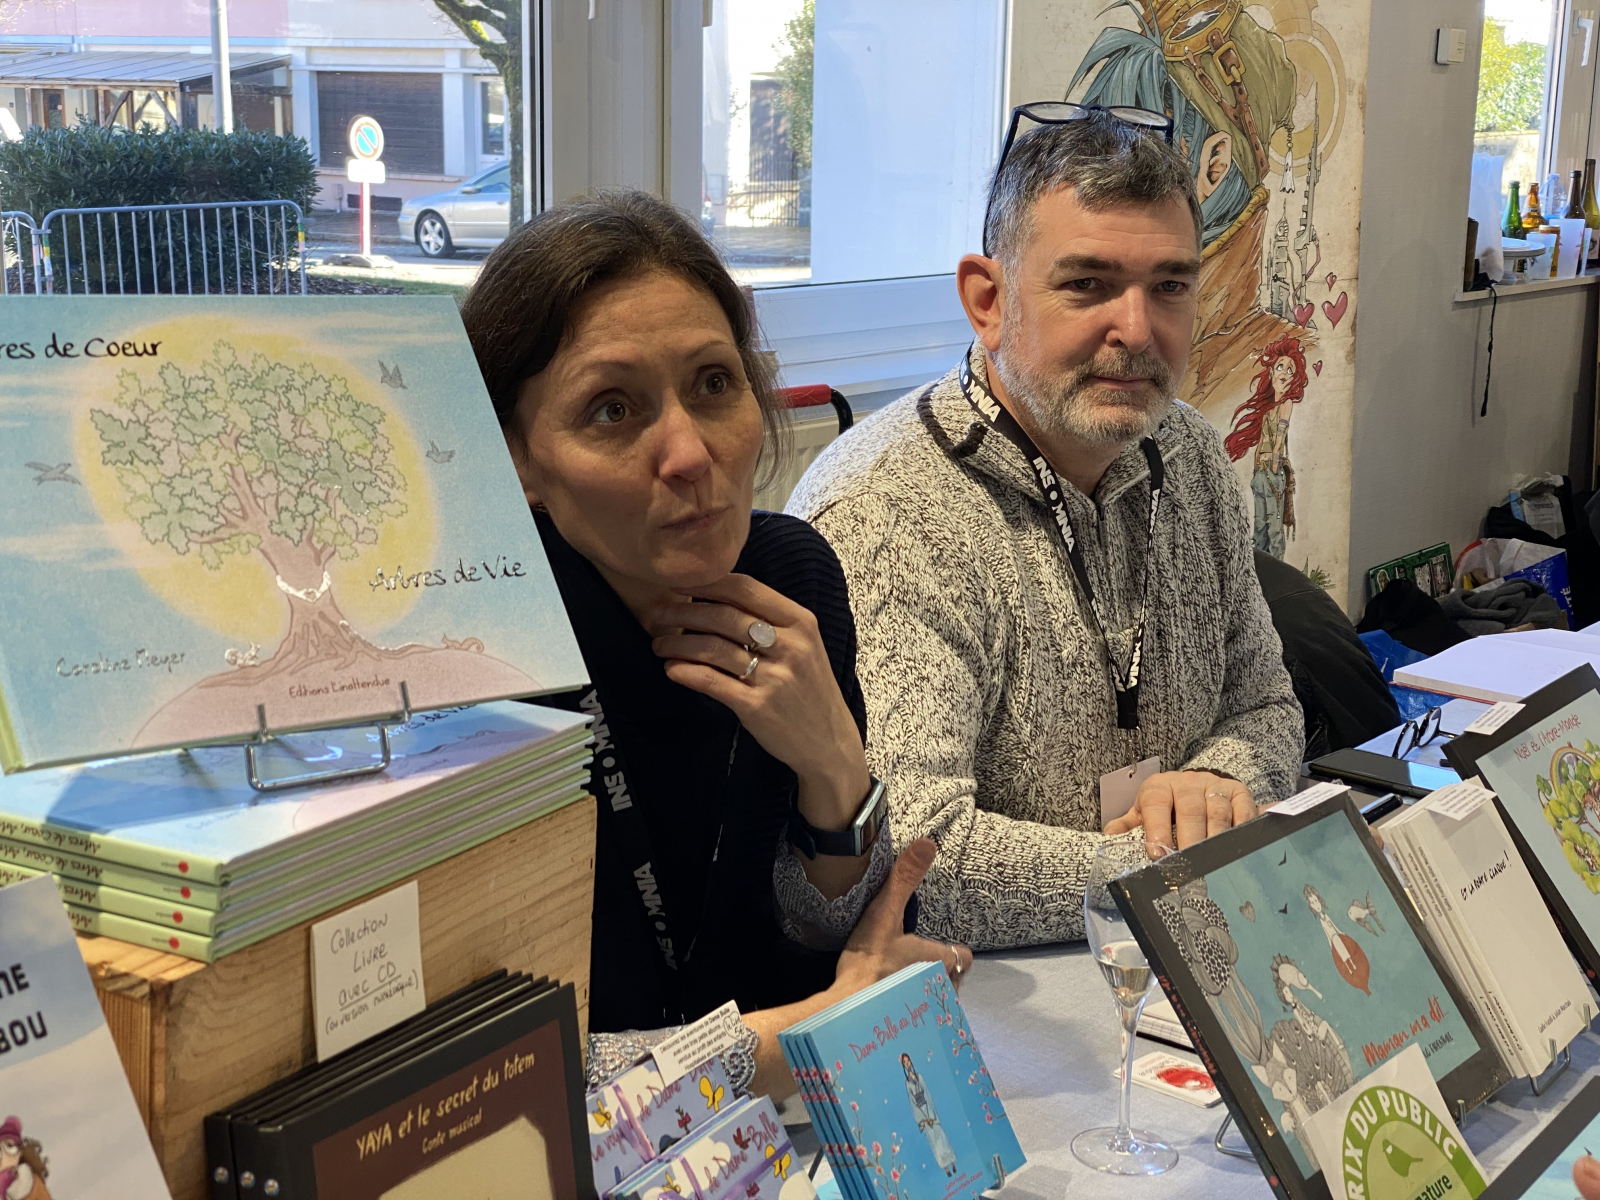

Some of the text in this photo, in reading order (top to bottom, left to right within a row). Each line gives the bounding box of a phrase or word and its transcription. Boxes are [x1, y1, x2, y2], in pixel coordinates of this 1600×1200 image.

[45, 332, 80, 358] de
[84, 337, 162, 358] Coeur
[370, 555, 527, 592] Arbres de Vie
[331, 913, 388, 955] Collection
[338, 962, 397, 1007] avec CD
[848, 1040, 877, 1063] Dame
[873, 1015, 899, 1047] Bulle
[1361, 1031, 1410, 1068] Maman
[356, 1053, 535, 1161] YAYA et le secret du totem
[637, 1094, 651, 1122] de
[646, 1081, 682, 1109] Dame
[422, 1107, 483, 1154] Conte musical
[1350, 1095, 1378, 1140] DU
[1376, 1089, 1458, 1160] PUBLIC
[704, 1112, 779, 1194] de Dame Bulle
